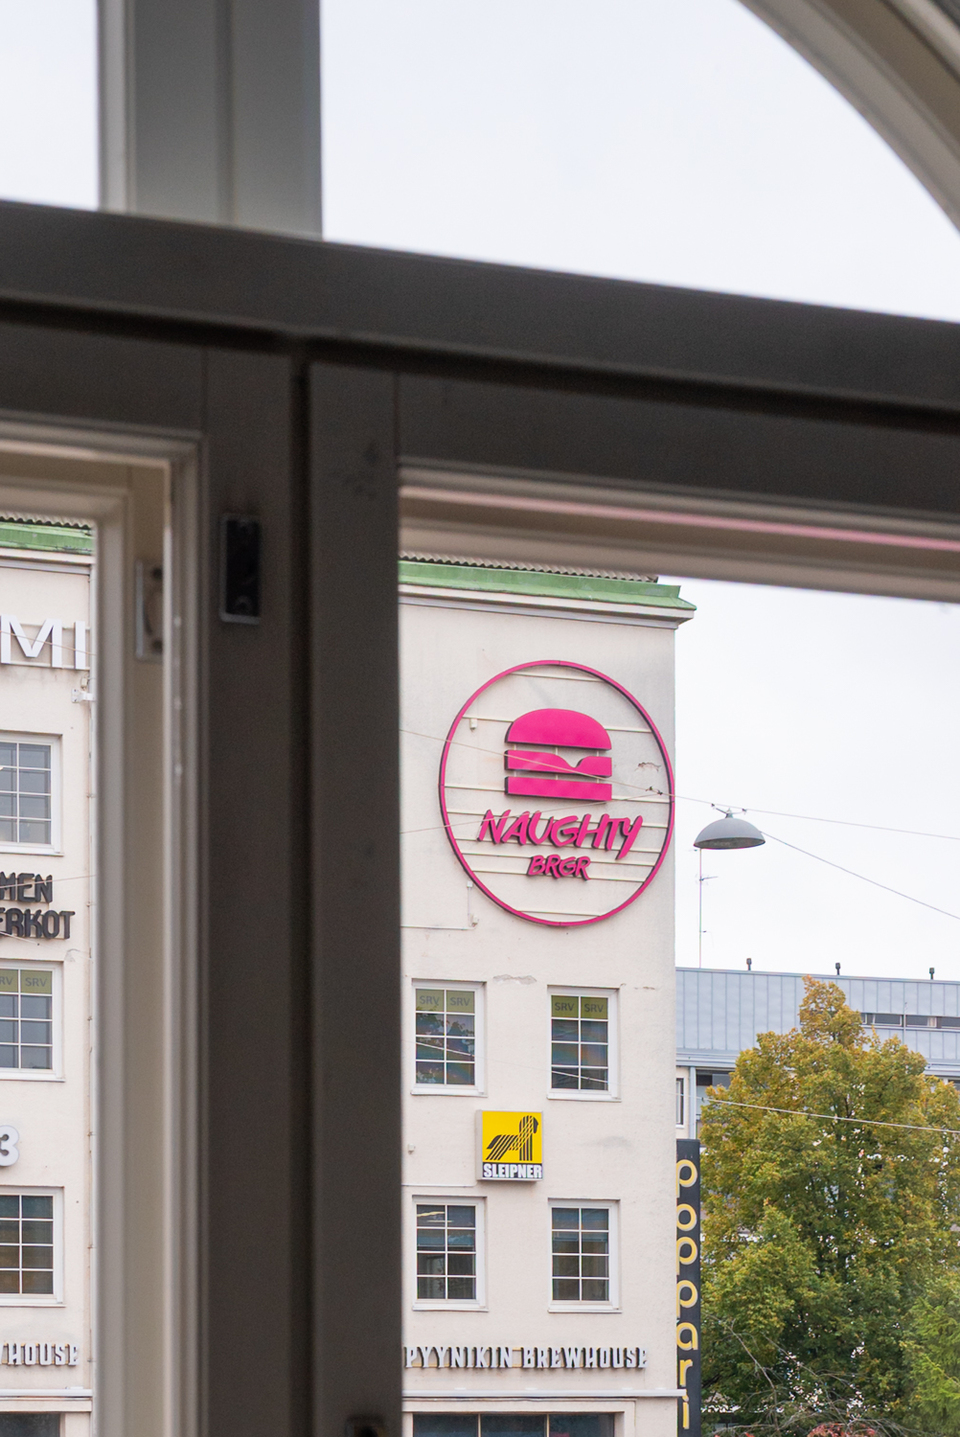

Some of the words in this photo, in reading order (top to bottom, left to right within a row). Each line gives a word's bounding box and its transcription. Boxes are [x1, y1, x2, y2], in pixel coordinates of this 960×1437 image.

[477, 809, 643, 860] NAUGHTY
[527, 854, 590, 881] BRGR
[25, 976, 48, 989] SRV
[419, 995, 440, 1006] SRV
[450, 996, 470, 1007] SRV
[554, 1001, 575, 1012] SRV
[584, 1003, 604, 1013] SRV
[483, 1163, 543, 1179] SLEIPNER
[677, 1158, 698, 1430] poppari
[404, 1347, 513, 1369] PYYNIKIN
[522, 1347, 648, 1370] BREWHOUSE
